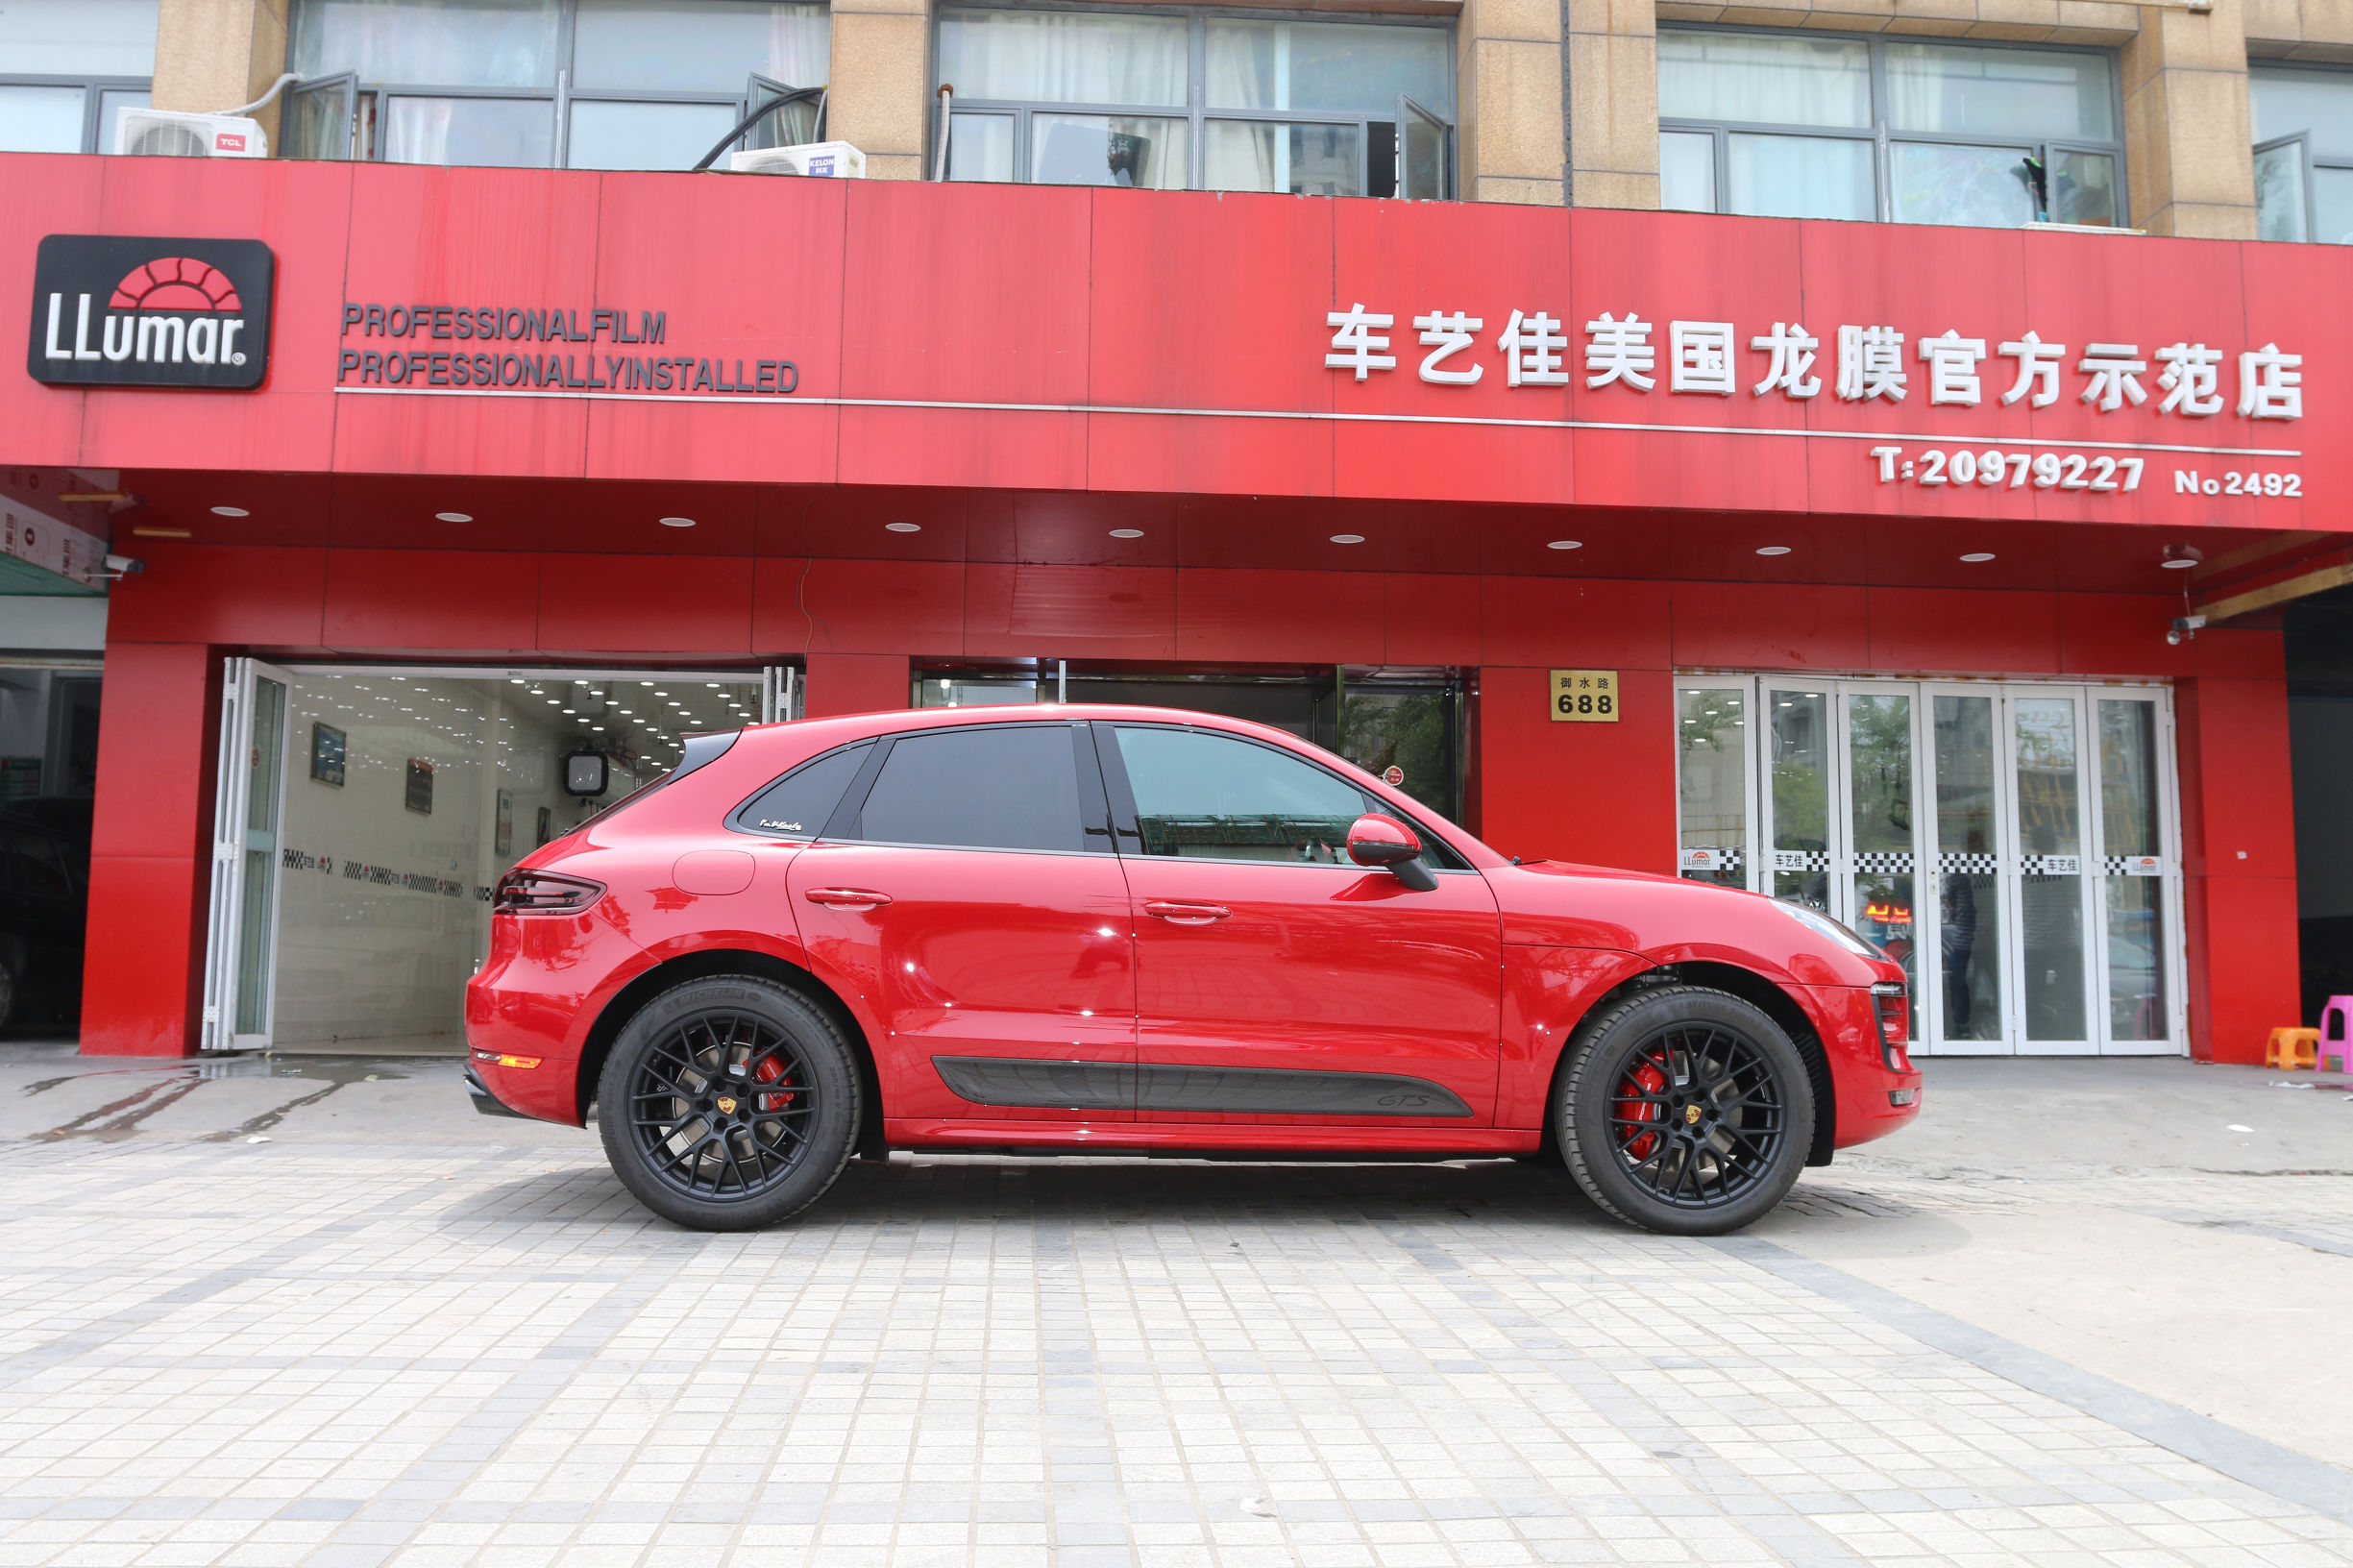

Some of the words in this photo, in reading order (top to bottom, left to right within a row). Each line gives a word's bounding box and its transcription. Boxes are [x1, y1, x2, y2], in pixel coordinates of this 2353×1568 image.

[220, 137, 242, 147] TCL
[809, 159, 834, 167] KELON
[1325, 302, 2304, 421] 车艺佳美国龙膜官方示范店
[1560, 676, 1609, 689] 御水路
[1557, 694, 1612, 714] 688
[1683, 856, 1711, 866] LLumar
[1776, 854, 1804, 868] 车艺佳
[2047, 859, 2078, 871] 车艺佳
[1378, 1095, 1430, 1106] GTS
